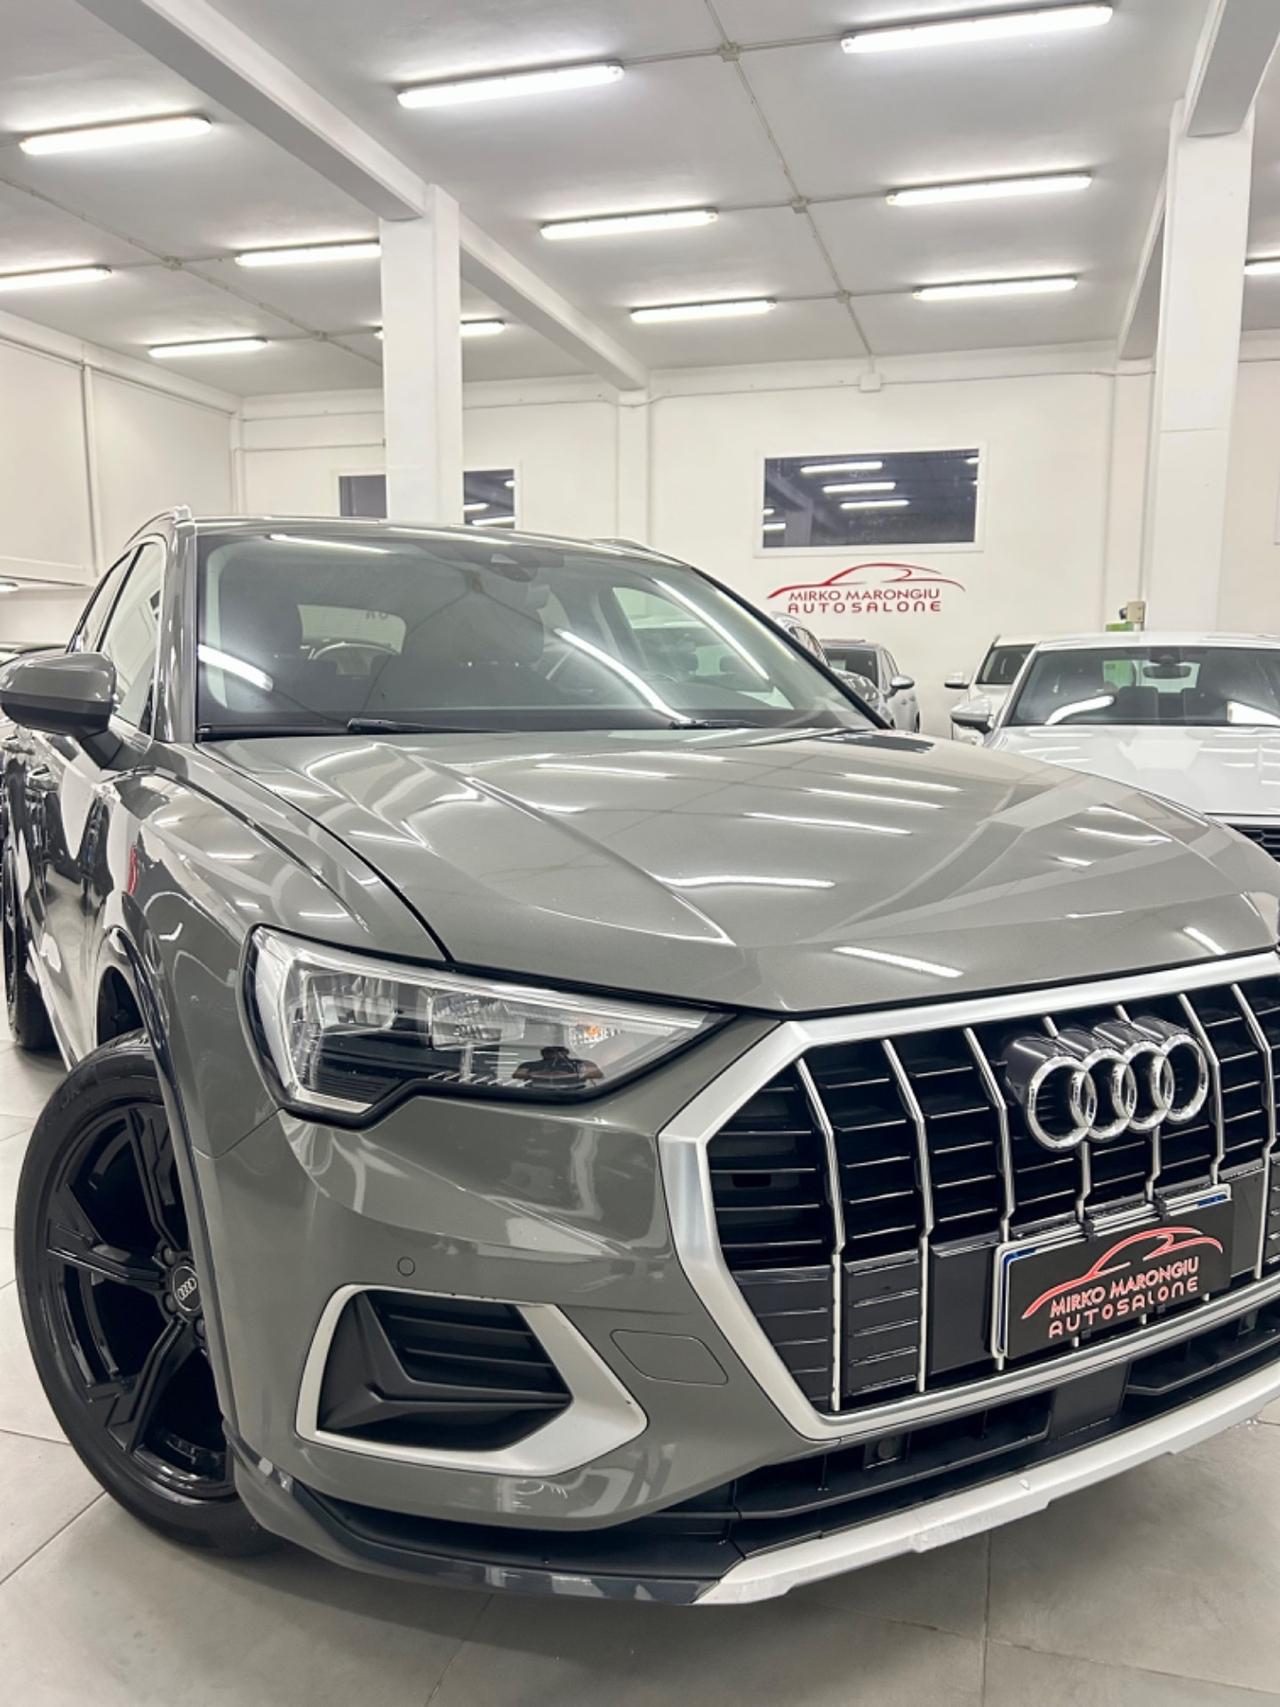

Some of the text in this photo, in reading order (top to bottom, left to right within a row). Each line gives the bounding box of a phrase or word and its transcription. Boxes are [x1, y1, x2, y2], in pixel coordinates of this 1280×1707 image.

[787, 600, 942, 613] AUTOSALONE
[789, 588, 940, 601] MIRKO MARONGIU
[1050, 1256, 1199, 1318] MIRKO MARONGIU
[1049, 1276, 1199, 1338] AUTOSALONE
